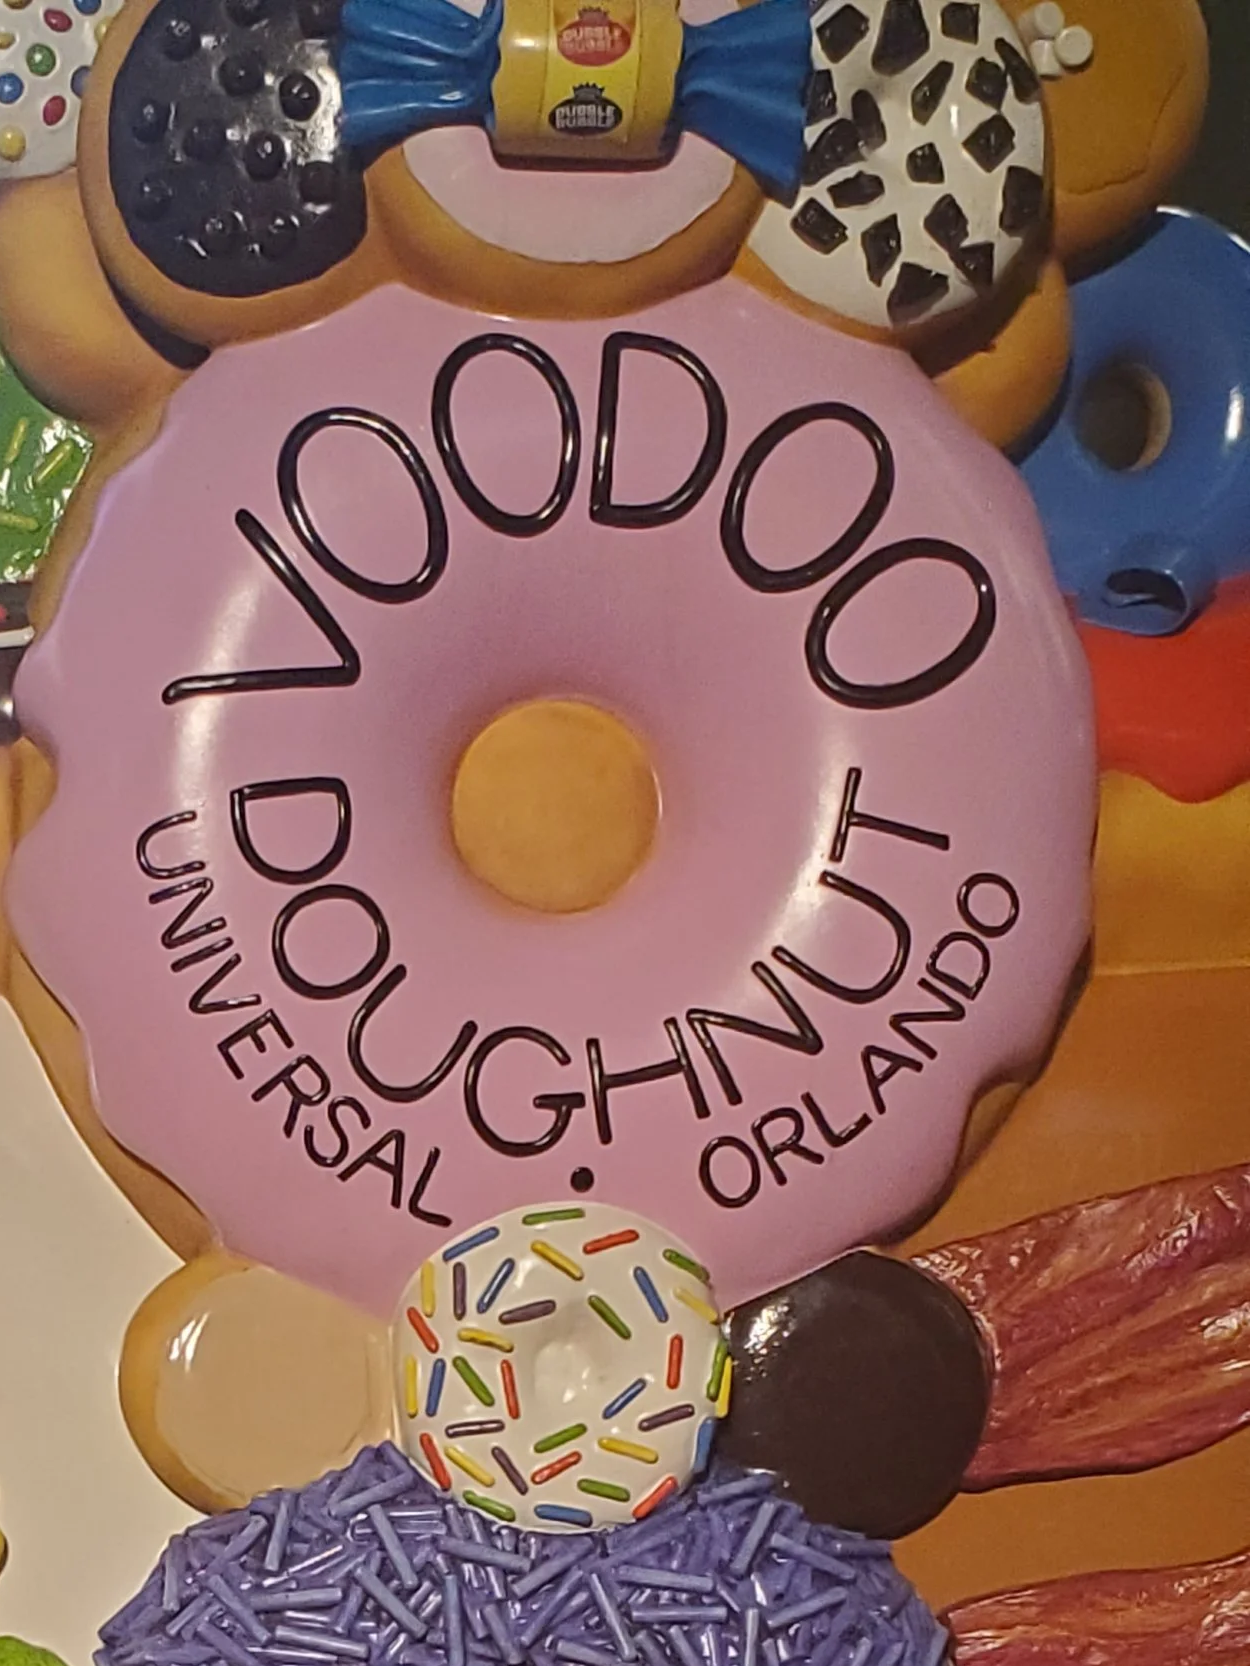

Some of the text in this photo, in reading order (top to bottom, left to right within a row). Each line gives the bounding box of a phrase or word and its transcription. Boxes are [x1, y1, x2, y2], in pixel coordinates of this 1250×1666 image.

[161, 331, 997, 709] VOODOO
[135, 810, 1021, 1228] UNIVERSAL ORLANDO
[230, 767, 950, 1157] DOUGHNUT
